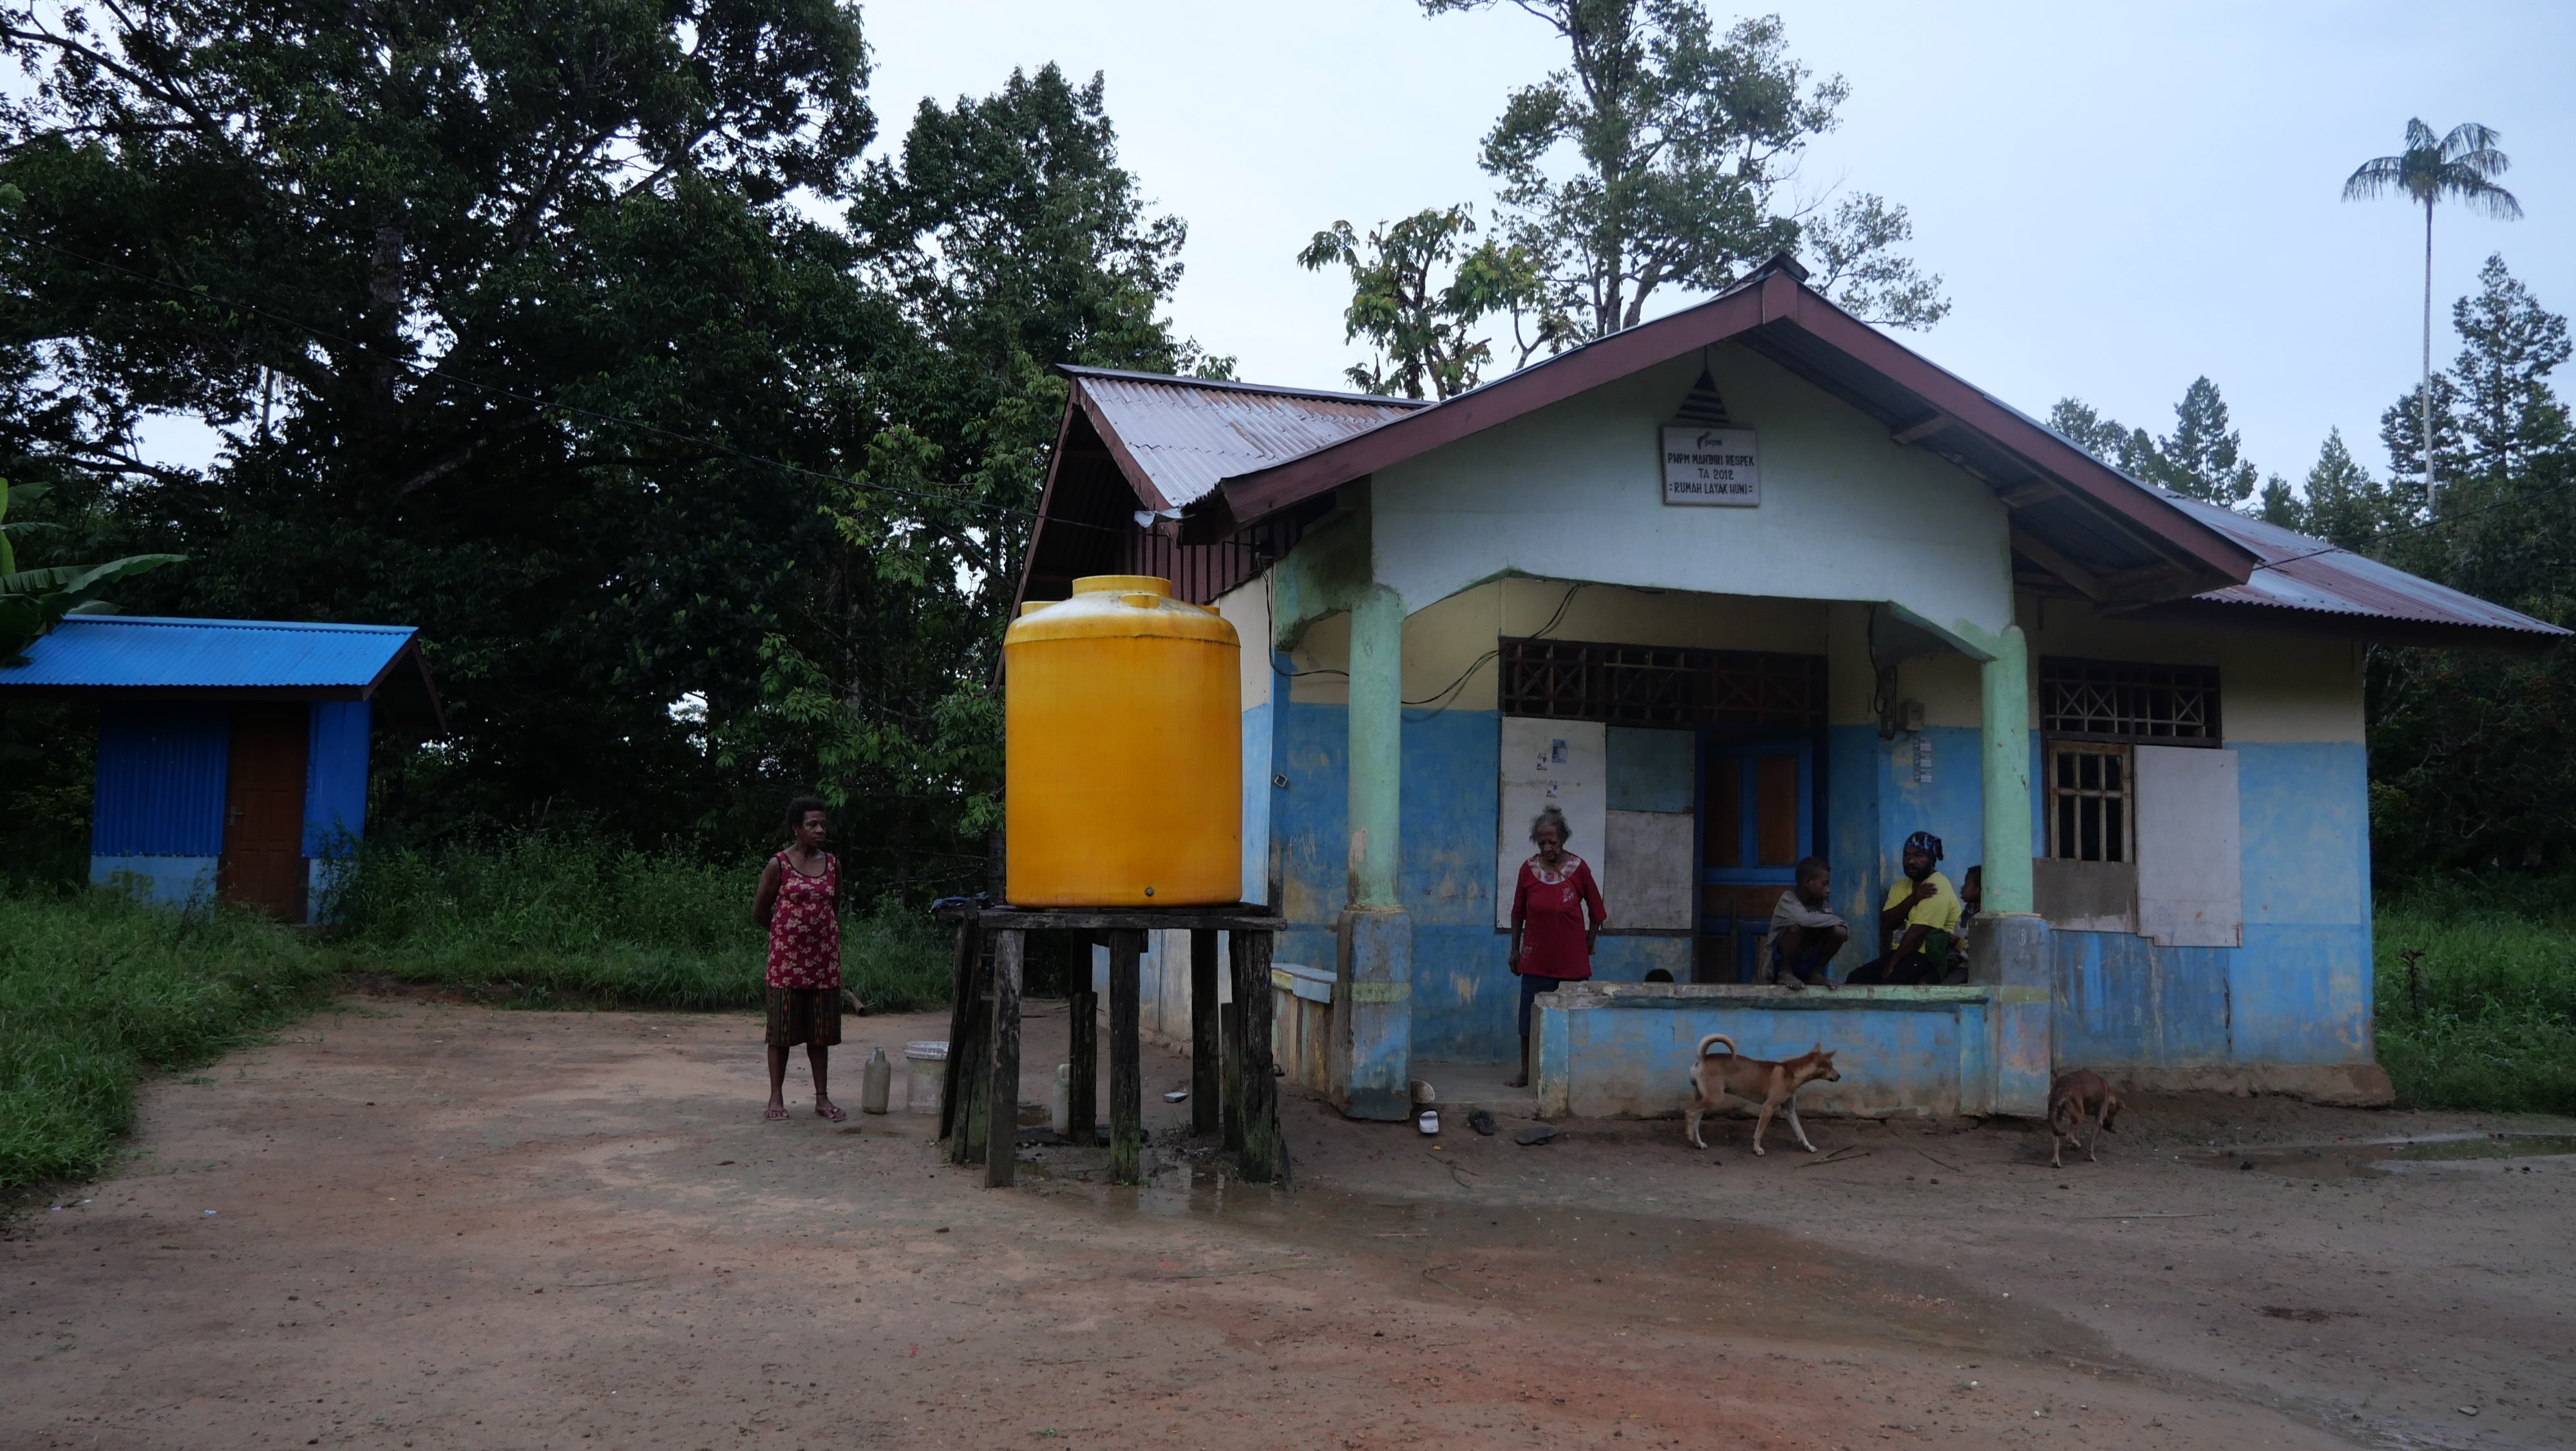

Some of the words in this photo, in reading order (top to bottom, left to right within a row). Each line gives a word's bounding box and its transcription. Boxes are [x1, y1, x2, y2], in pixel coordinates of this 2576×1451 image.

[1668, 453, 1690, 464] PNPM
[1692, 453, 1723, 465] MANDIRI
[1725, 455, 1754, 466] RESPEK
[1698, 468, 1709, 479] TA
[1713, 469, 1734, 480] 2012
[1705, 483, 1728, 494] LAYAK
